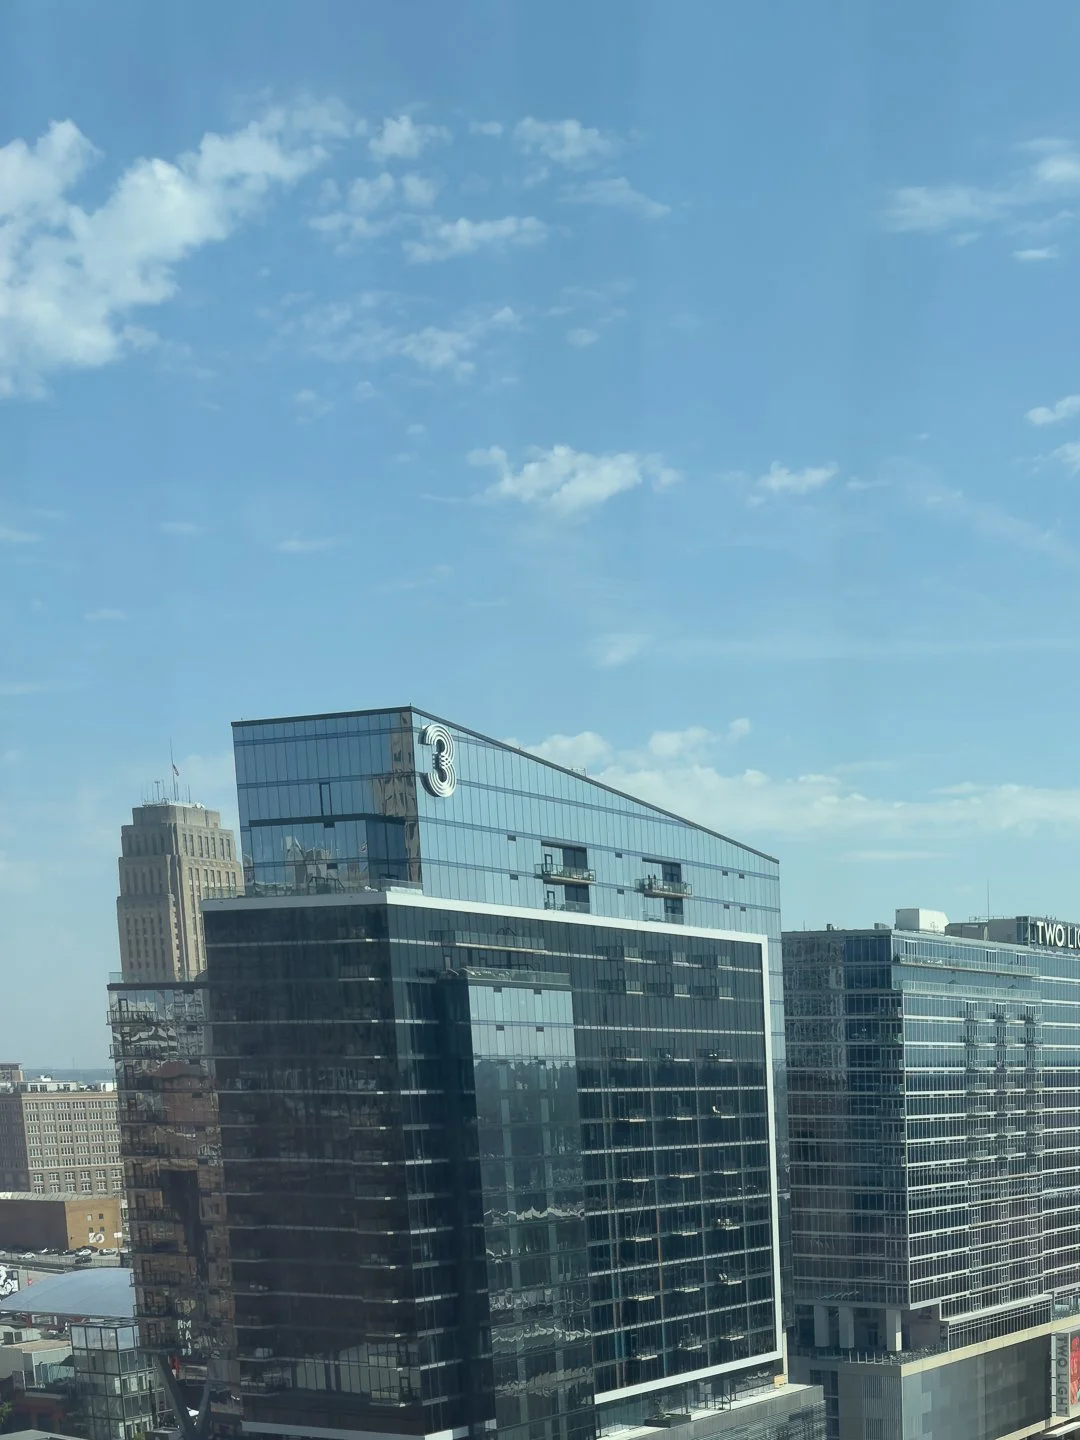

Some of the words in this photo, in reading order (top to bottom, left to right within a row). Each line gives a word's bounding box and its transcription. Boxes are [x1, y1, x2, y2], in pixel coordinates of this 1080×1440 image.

[421, 724, 457, 797] 3
[1036, 921, 1065, 947] TWO
[1057, 1335, 1067, 1368] TWO
[1057, 1373, 1067, 1415] LIGHT
